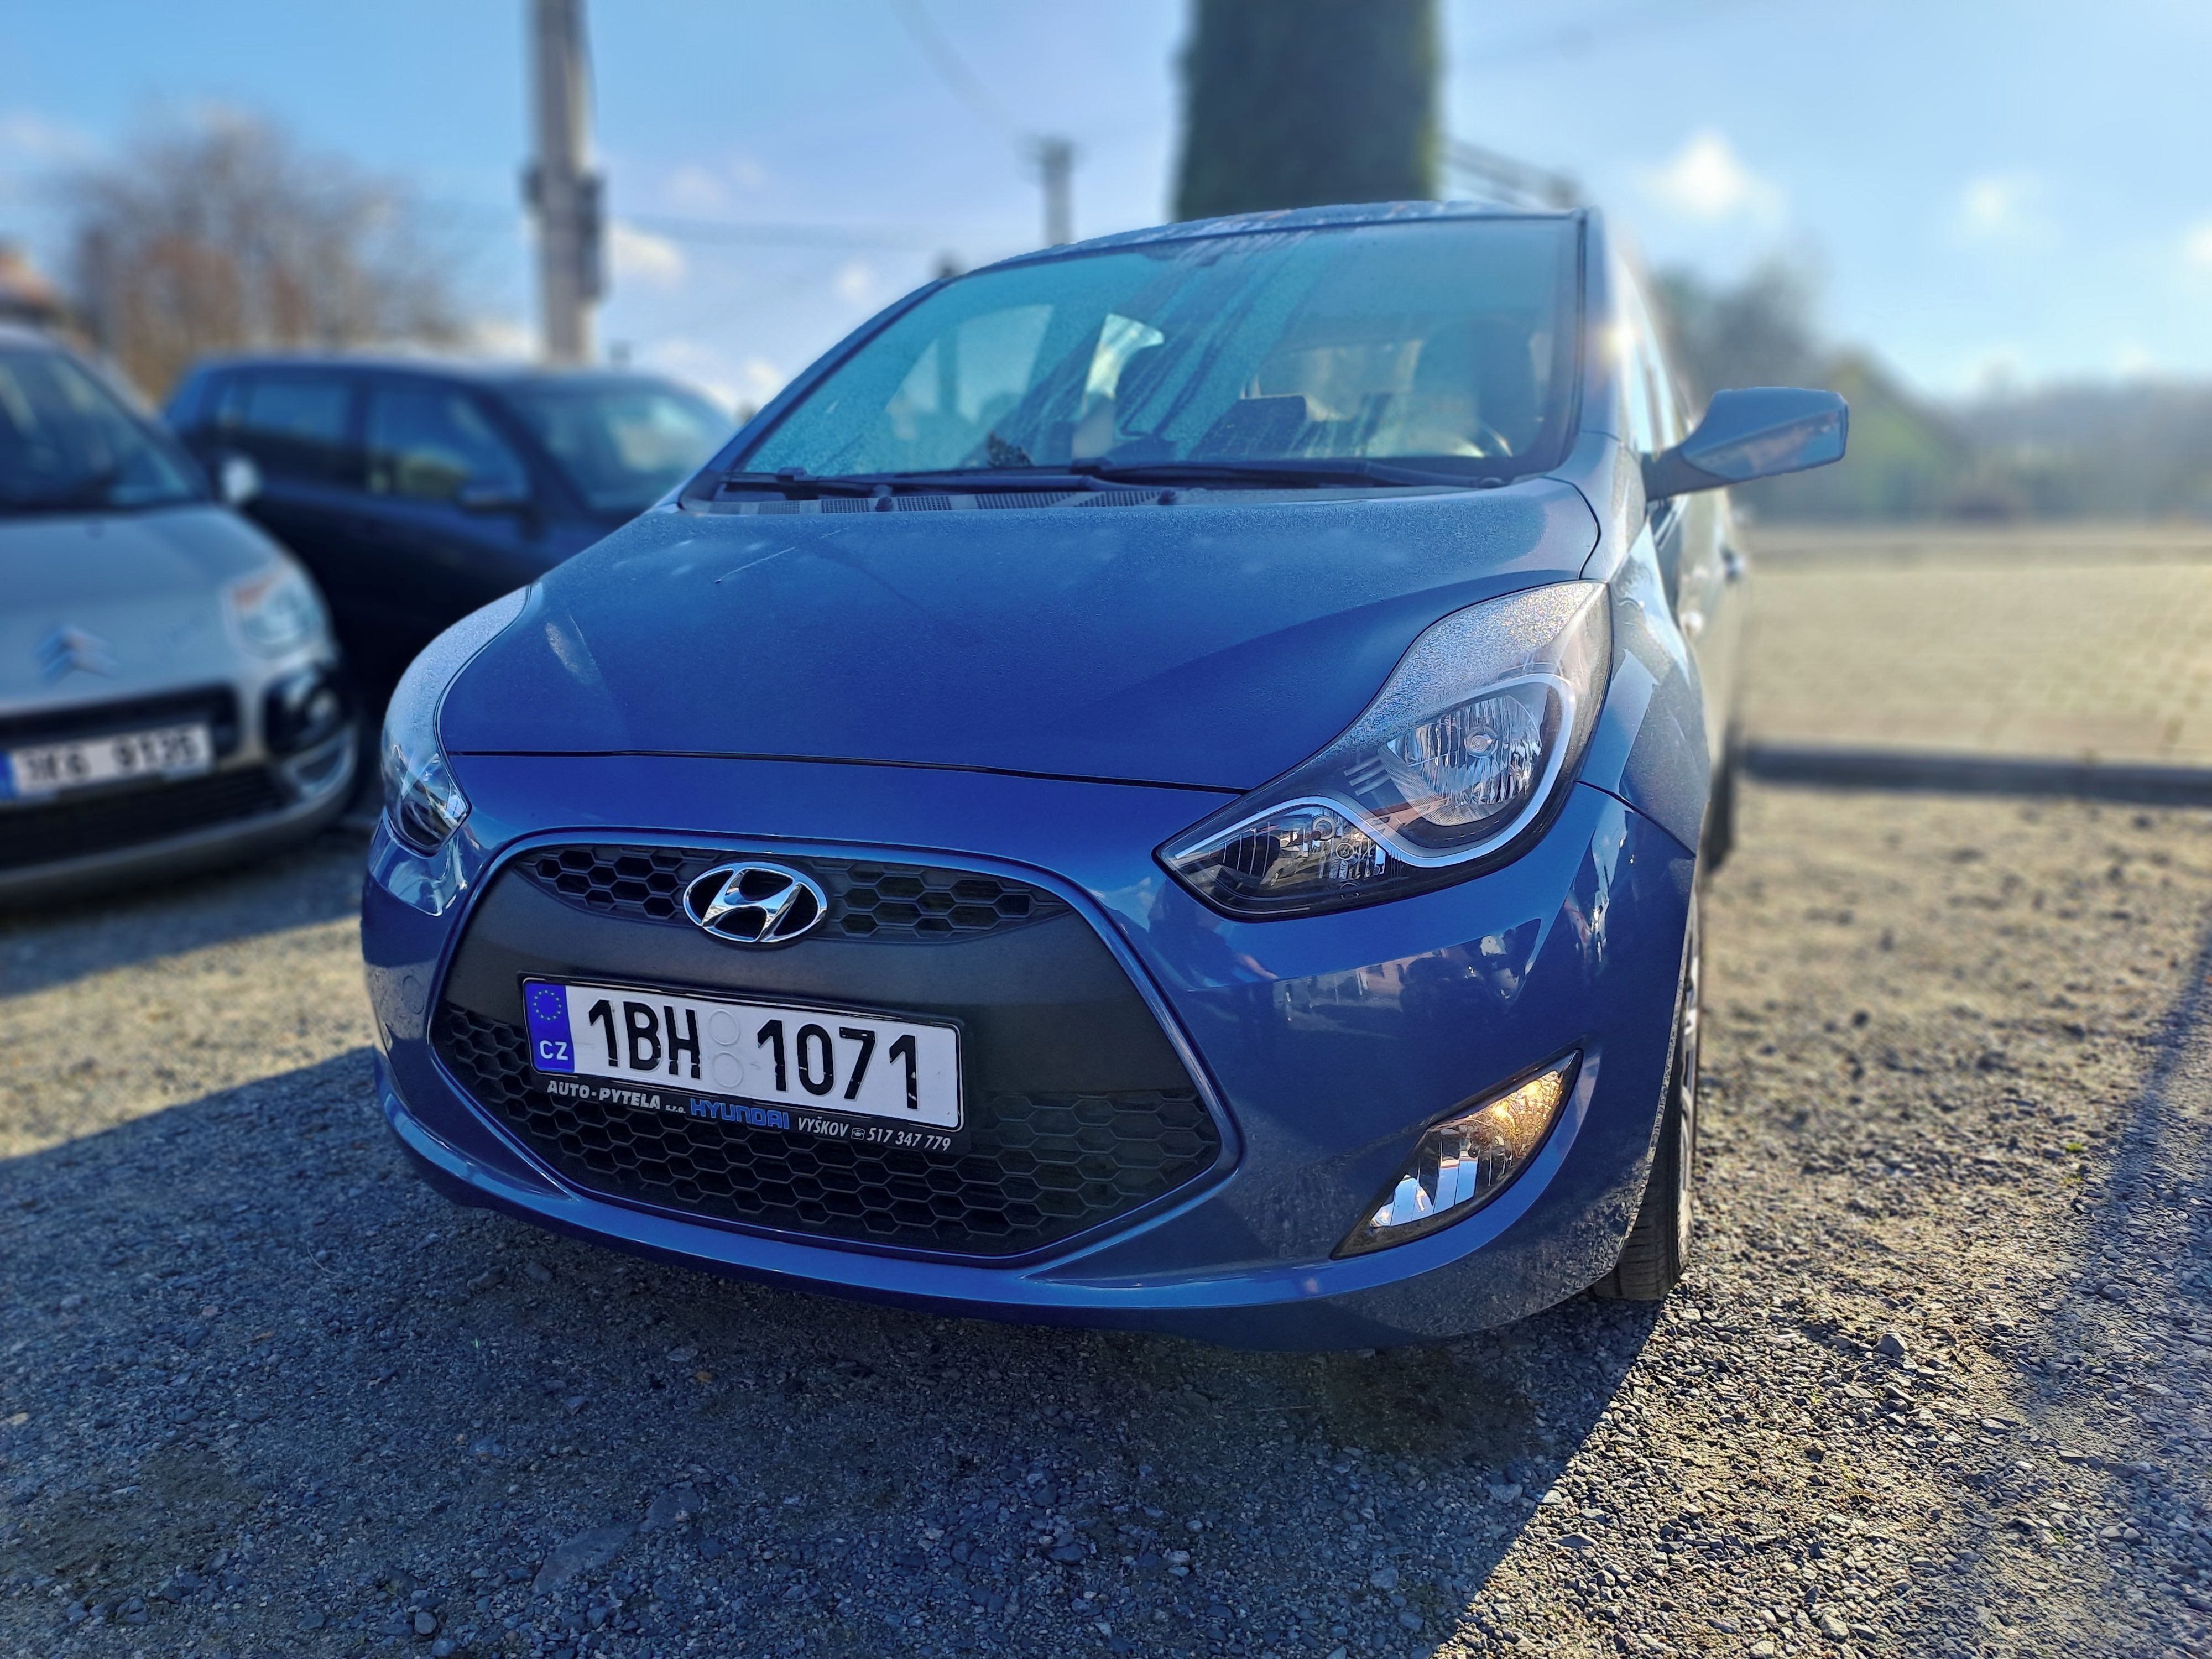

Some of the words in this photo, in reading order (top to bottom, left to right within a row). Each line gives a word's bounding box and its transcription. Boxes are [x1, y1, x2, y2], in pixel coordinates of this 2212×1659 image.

[539, 1040, 569, 1061] CZ
[588, 999, 701, 1079] 1BH
[757, 1019, 919, 1110] 1071
[546, 1080, 661, 1110] AUTO-PYTELA
[690, 1098, 790, 1130] HYUNDAI
[797, 1116, 849, 1138] VYŠKOV
[867, 1128, 894, 1143] 517
[895, 1131, 922, 1147] 347
[924, 1135, 951, 1151] 779
